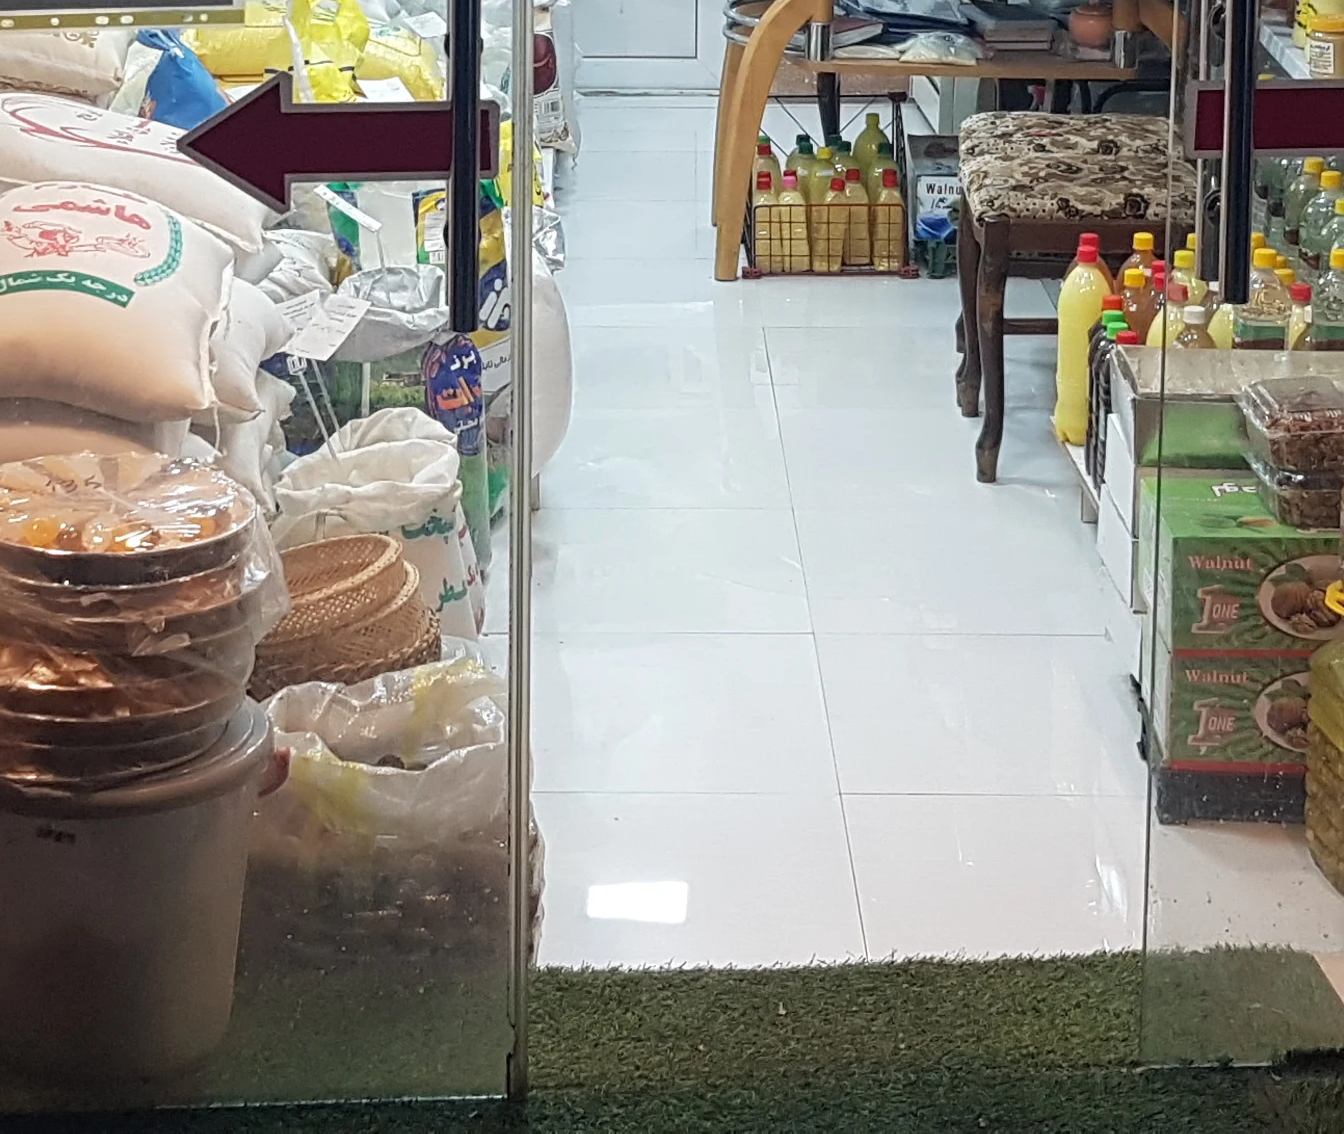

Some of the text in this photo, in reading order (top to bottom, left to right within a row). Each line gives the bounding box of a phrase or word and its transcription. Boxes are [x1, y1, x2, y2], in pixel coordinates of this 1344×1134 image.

[925, 183, 962, 196] Walnu
[12, 198, 152, 231] هاشمی
[45, 271, 77, 285] یک
[80, 276, 130, 304] درجه
[1187, 554, 1254, 572] Walnut
[1211, 602, 1241, 619] ONE
[1185, 668, 1250, 685] Walnut
[1208, 715, 1236, 733] ONE
